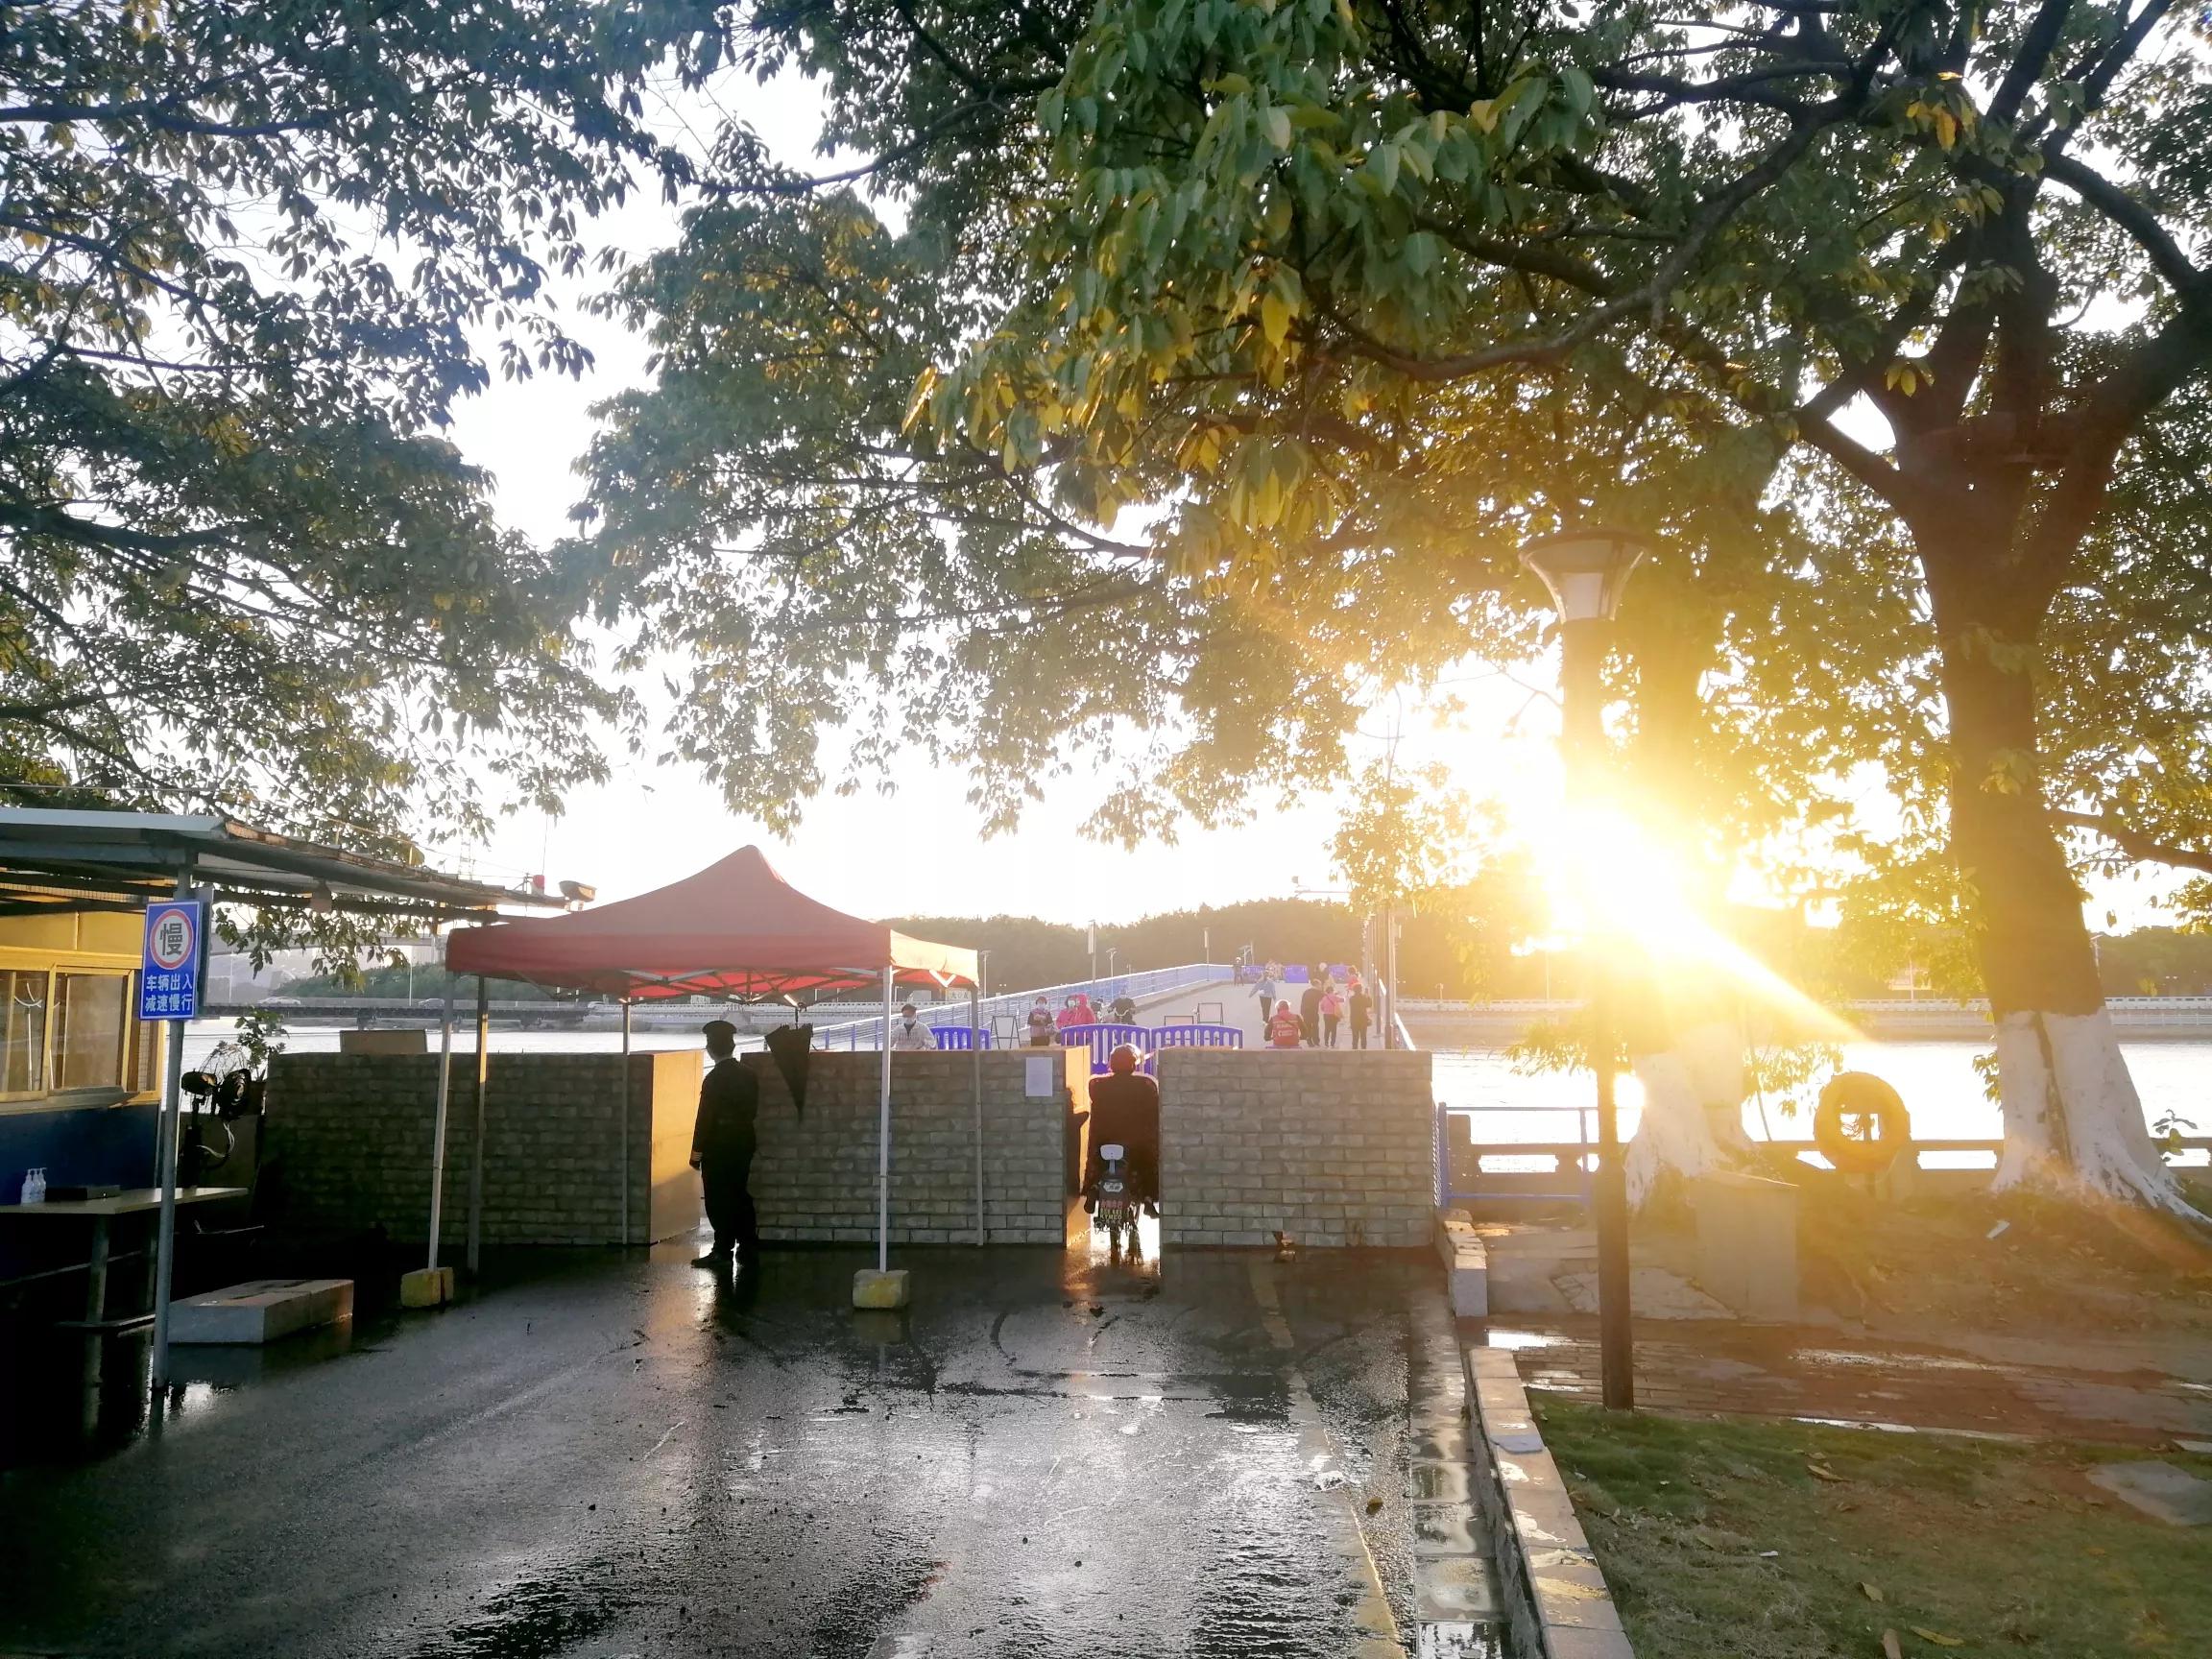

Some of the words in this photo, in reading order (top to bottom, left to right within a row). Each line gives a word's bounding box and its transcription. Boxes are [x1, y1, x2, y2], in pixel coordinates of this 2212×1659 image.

[159, 923, 183, 955] 慢
[146, 974, 192, 991] 车辆出入
[145, 994, 192, 1012] 减速慢行
